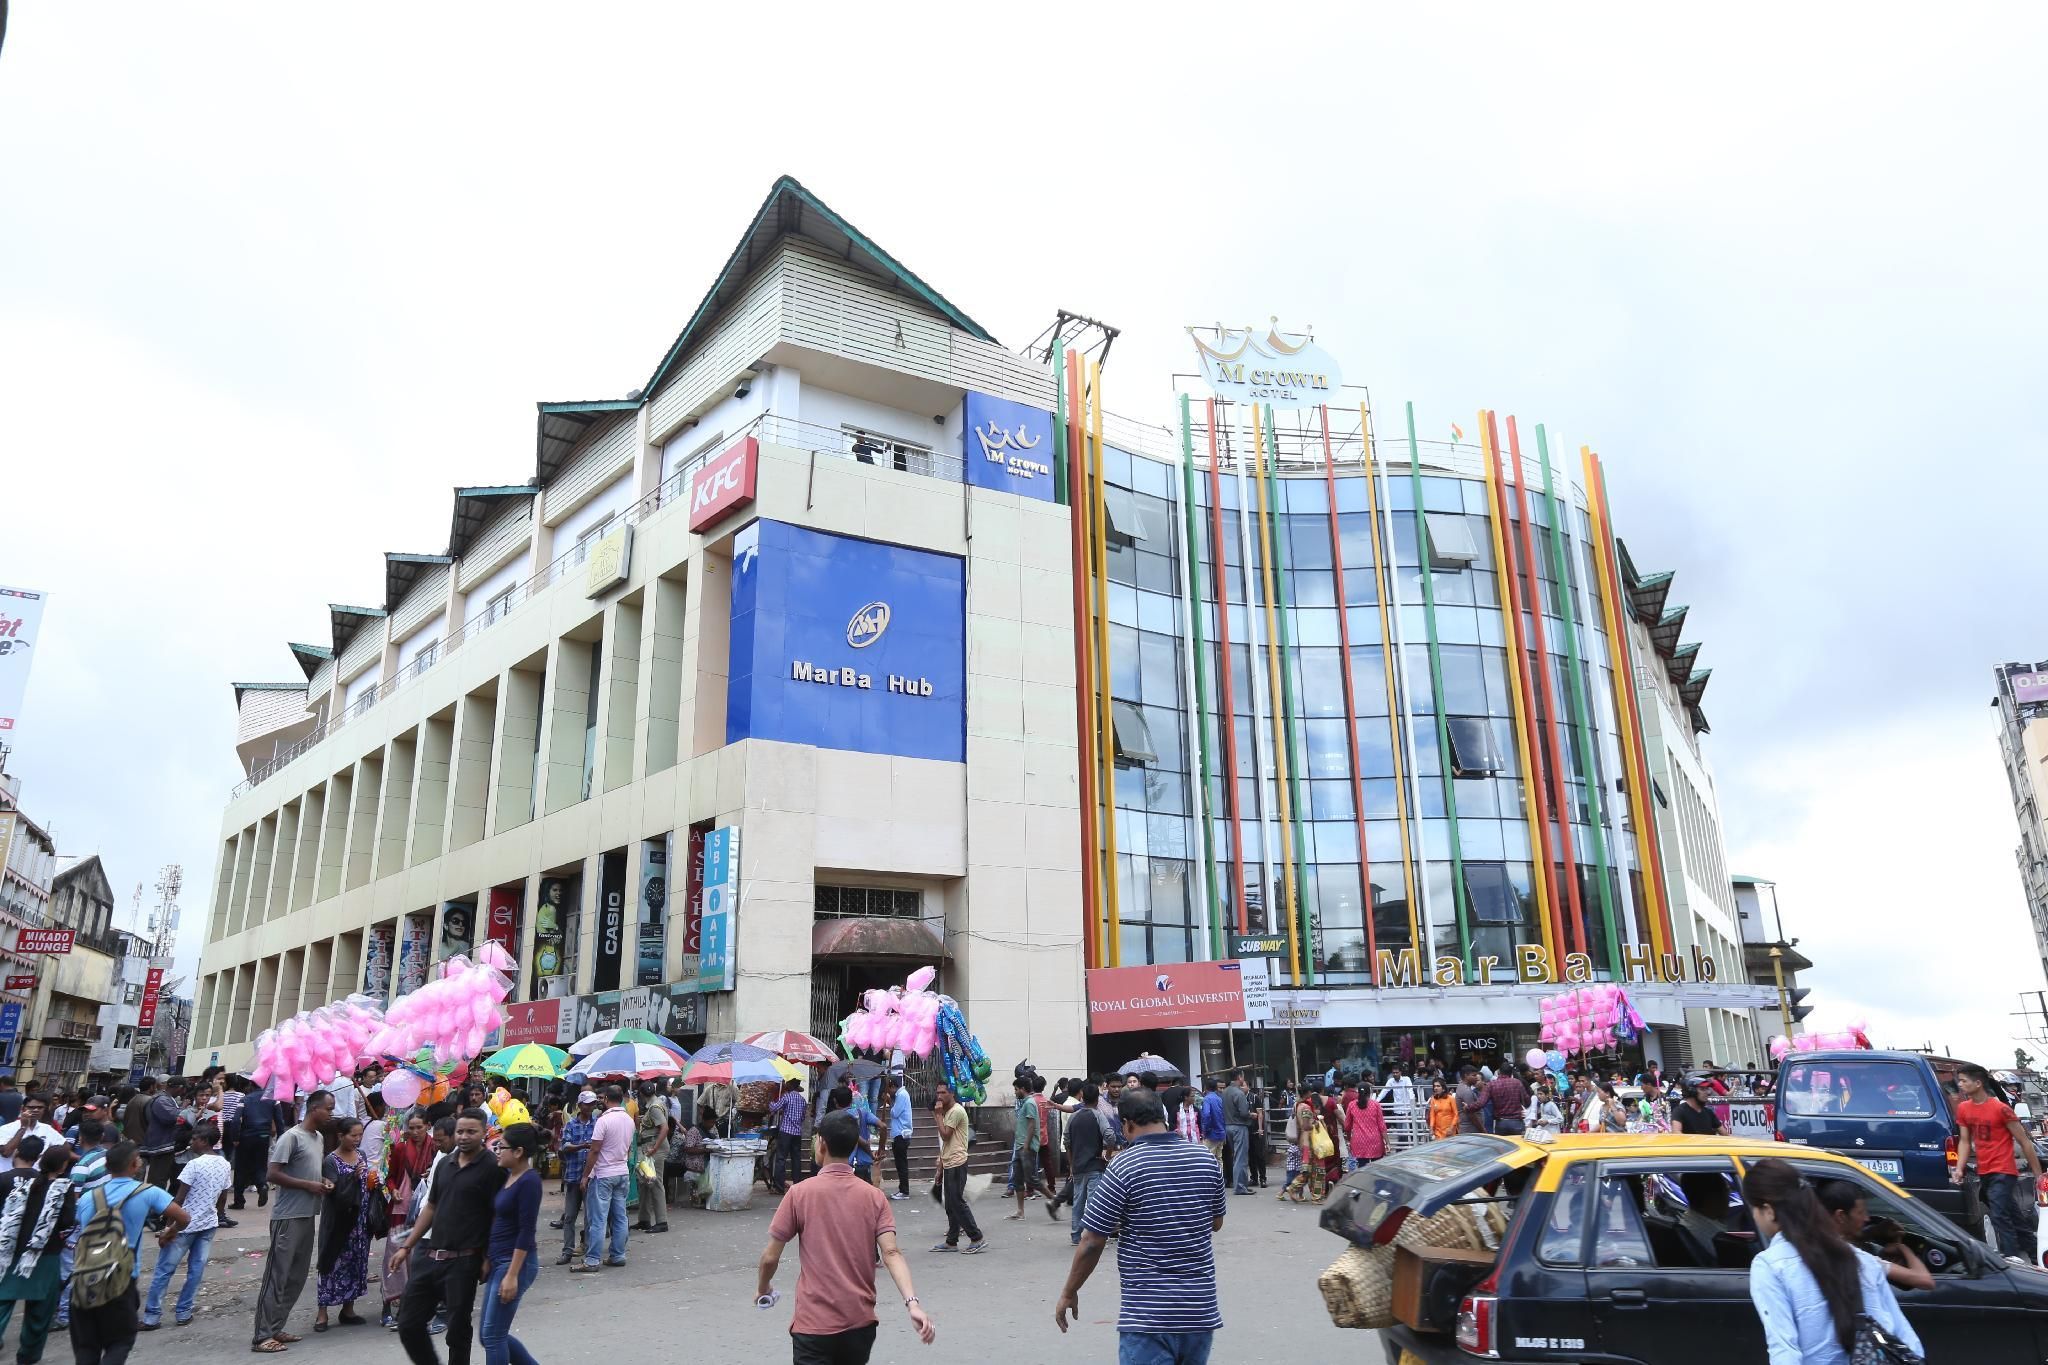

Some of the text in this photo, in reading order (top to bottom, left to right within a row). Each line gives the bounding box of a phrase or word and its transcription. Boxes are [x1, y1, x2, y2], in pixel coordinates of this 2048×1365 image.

[1216, 362, 1329, 390] M crown
[1249, 387, 1298, 400] HOTEL
[990, 449, 1049, 475] M crown
[1007, 466, 1034, 479] HOTEL
[692, 454, 744, 514] KFC
[791, 660, 933, 696] MarBa Hub
[712, 834, 721, 881] SBI
[605, 891, 621, 955] CASIO
[25, 930, 69, 942] MIKADO
[708, 918, 718, 967] ATM
[19, 942, 70, 952] LOUNGE
[1238, 940, 1283, 953] SUBWAY
[1375, 943, 1717, 989] MarBa Hub
[621, 995, 647, 1011] MITHILA
[1091, 991, 1242, 1013] ROYAL GLOBAL UNIVERSITY
[1248, 1000, 1269, 1008] (MUDA)
[1459, 1038, 1497, 1050] ENDS
[1732, 1109, 1768, 1127] POLIC
